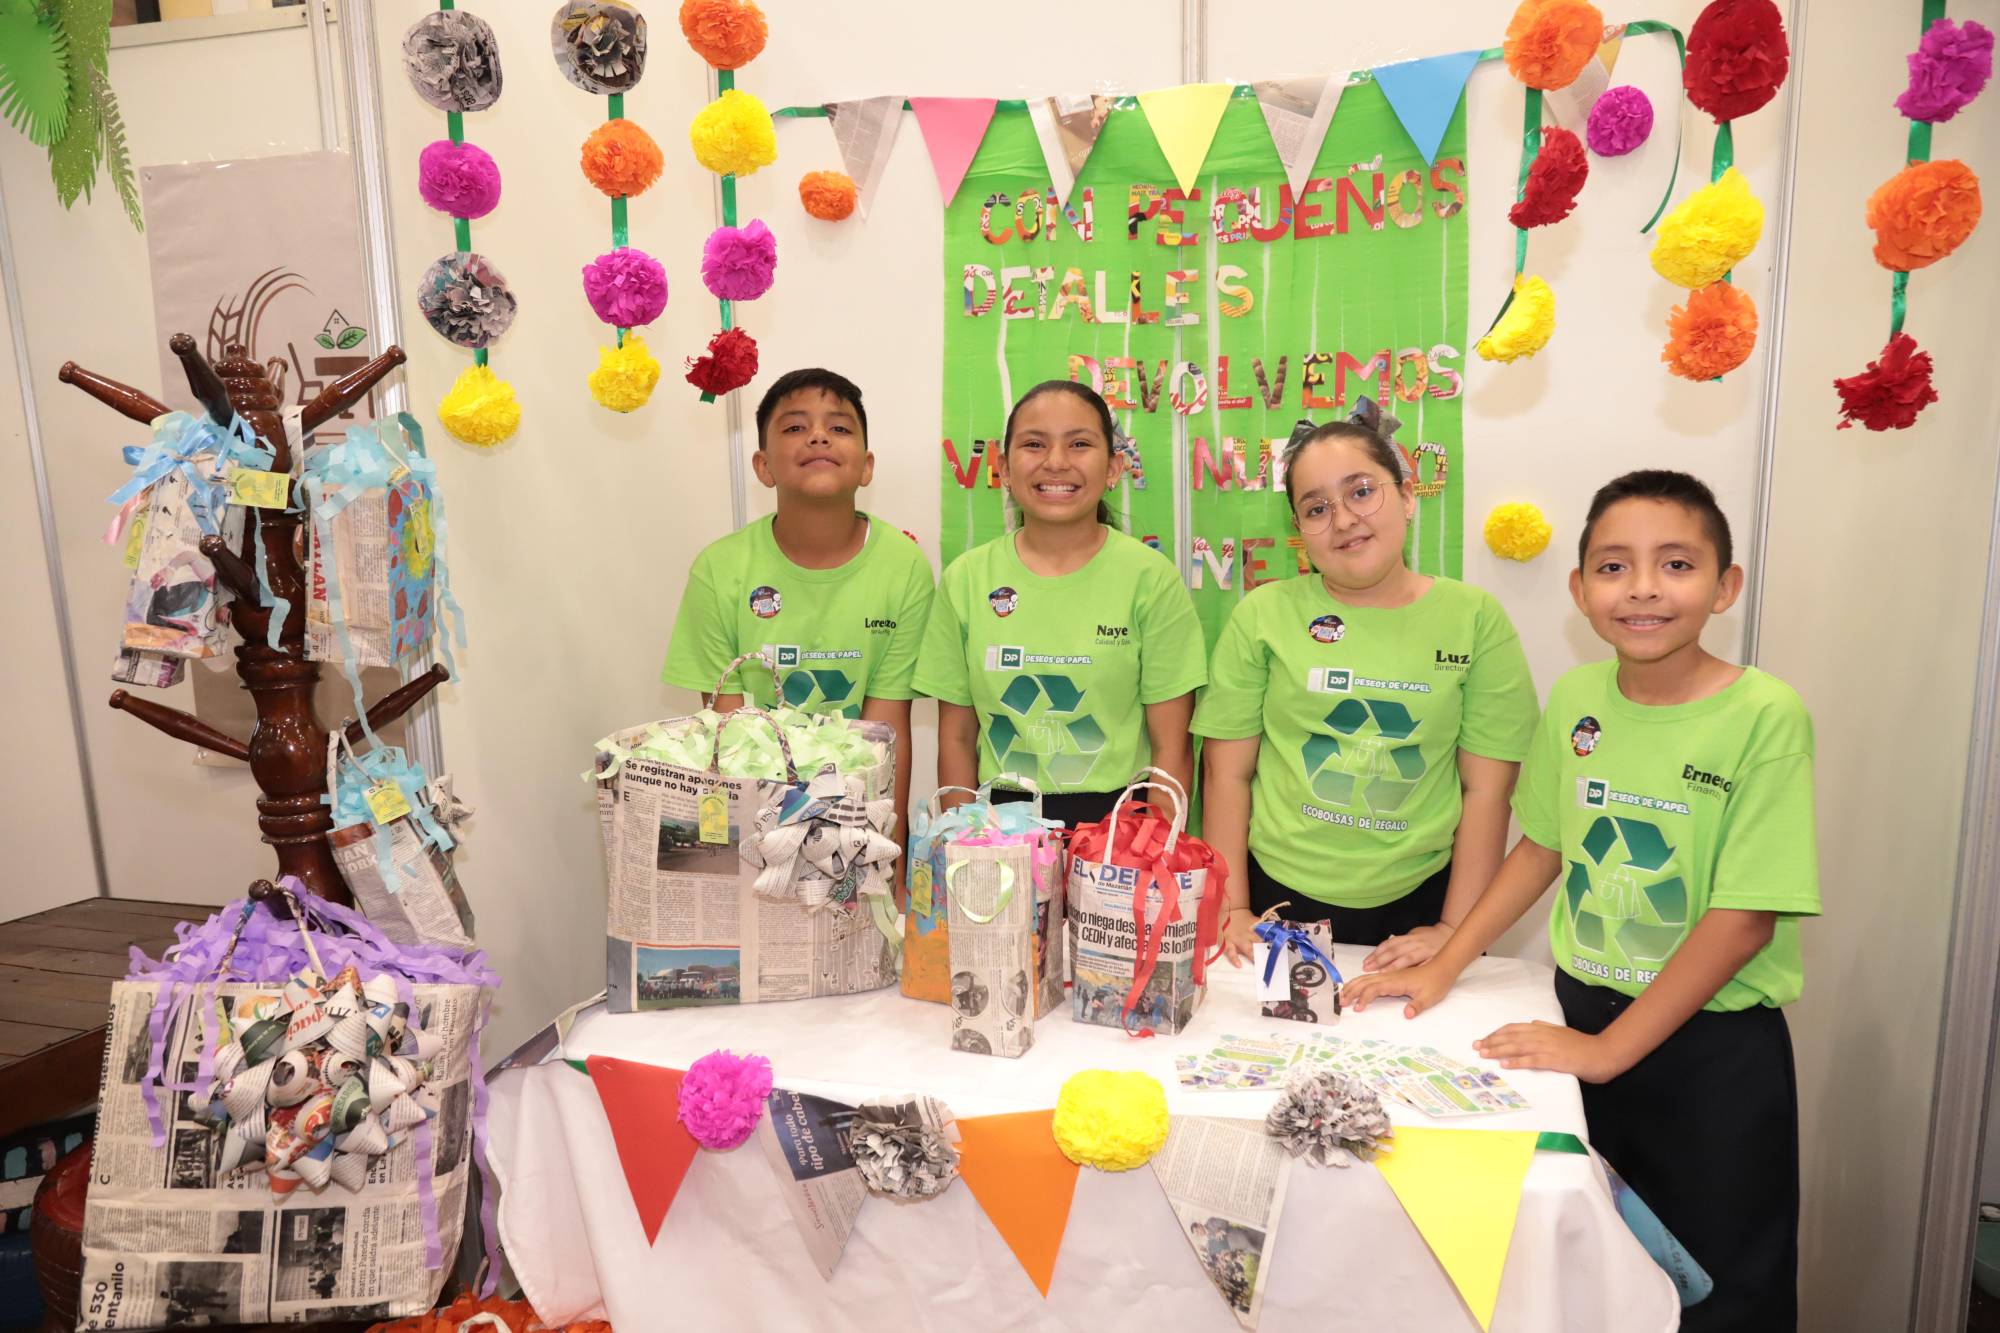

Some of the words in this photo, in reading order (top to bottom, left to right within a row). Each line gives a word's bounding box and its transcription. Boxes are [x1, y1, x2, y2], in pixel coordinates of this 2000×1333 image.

[980, 187, 1094, 245] CON
[1128, 154, 1466, 247] PEQUEÑOS
[964, 264, 1254, 327] DETALLES
[1069, 344, 1464, 415] DEVOLVEMOS
[1097, 624, 1128, 639] Naye
[838, 650, 862, 659] PAPEL
[1004, 654, 1018, 662] DP
[1025, 655, 1054, 663] DESEOS
[1055, 656, 1066, 664] DE
[1067, 656, 1092, 664] PAPEL
[1436, 650, 1470, 664] Luz
[1330, 676, 1346, 684] DP
[1354, 677, 1386, 688] DESEOS
[1388, 681, 1400, 690] DE
[1402, 682, 1431, 693] PAPEL
[625, 760, 638, 770] Se
[640, 764, 685, 781] registran
[688, 774, 742, 790] apgnes
[625, 772, 662, 786] aunque
[664, 780, 677, 790] no
[680, 784, 698, 796] hay
[1682, 764, 1732, 792] Erneo
[1589, 788, 1602, 798] DP
[1642, 796, 1654, 808] DE
[1656, 800, 1690, 815] PAPEL
[1302, 804, 1354, 826] ECOBOLSAS
[1358, 818, 1370, 828] DE
[1375, 820, 1408, 831] REGALO
[1073, 856, 1088, 878] EL
[1088, 913, 1114, 930] niega
[1082, 926, 1106, 945] CEDH
[1107, 935, 1114, 948] y
[1172, 940, 1182, 954] lo
[1615, 968, 1630, 981] DE
[440, 998, 450, 1032] hombre
[784, 1114, 798, 1138] todo
[800, 1127, 814, 1144] de
[793, 1138, 808, 1166] Para
[808, 1145, 824, 1170] tipo
[358, 1234, 368, 1268] Paredes
[357, 1270, 366, 1298] Beatriz
[368, 1269, 377, 1284] que
[90, 1282, 108, 1314] 530
[367, 1286, 374, 1297] en
